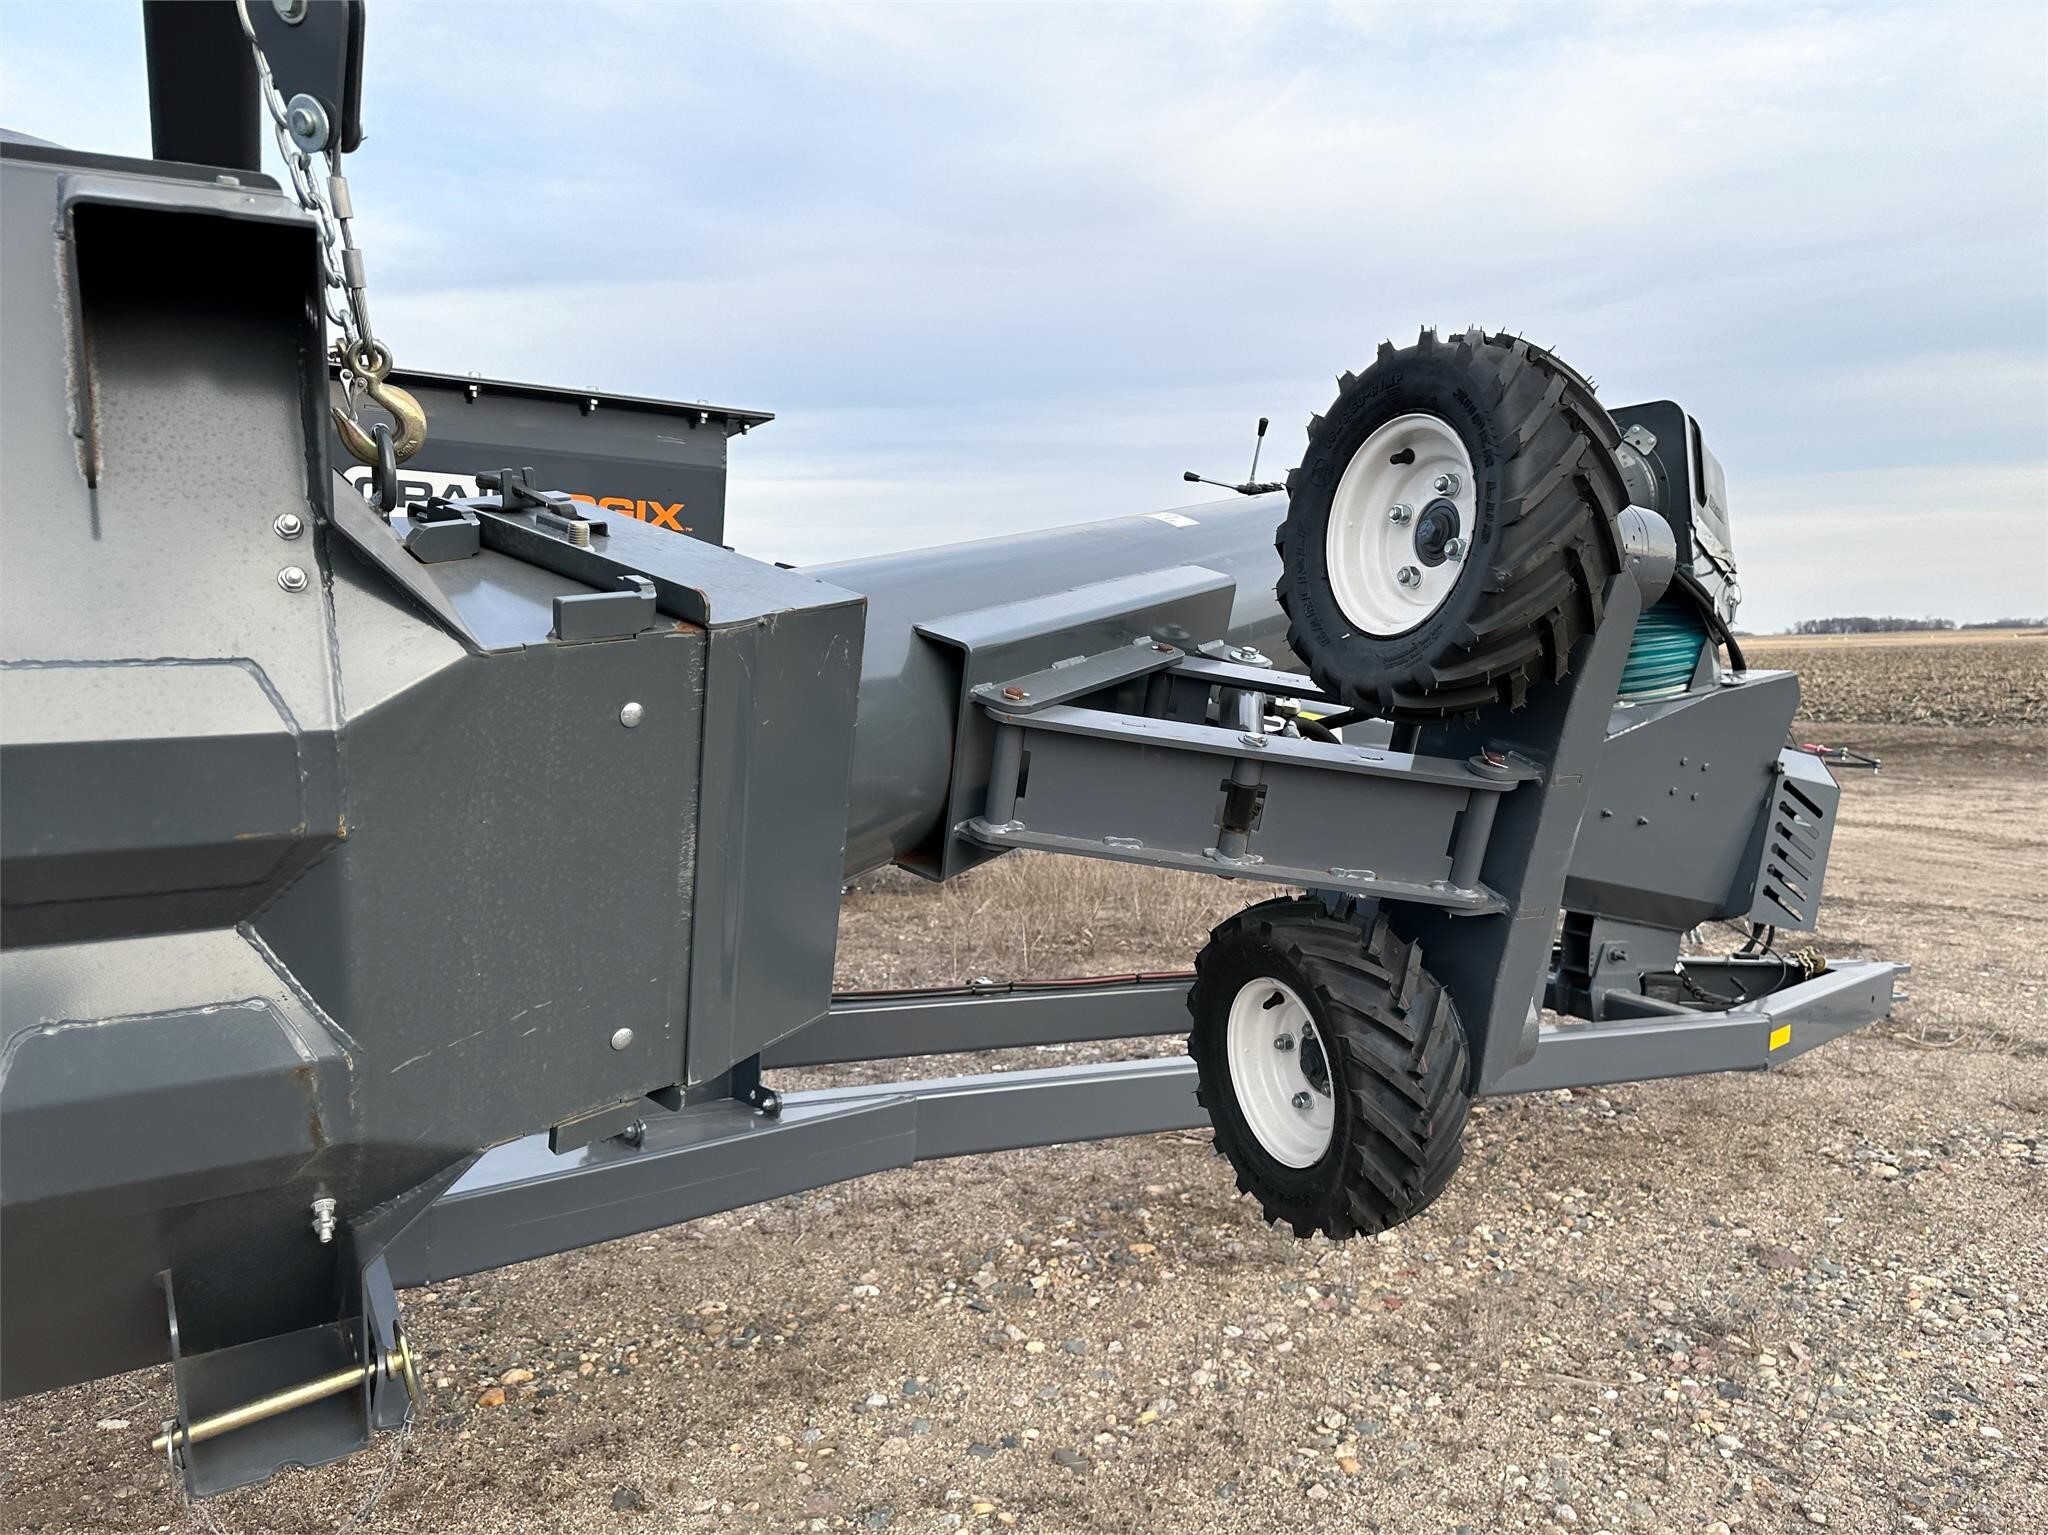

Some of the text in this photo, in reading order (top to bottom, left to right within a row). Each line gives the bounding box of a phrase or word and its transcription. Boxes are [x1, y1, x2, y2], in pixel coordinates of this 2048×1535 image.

[397, 440, 418, 457] CHINA
[570, 494, 685, 532] GIX
[1295, 518, 1331, 648] CARLISLE
